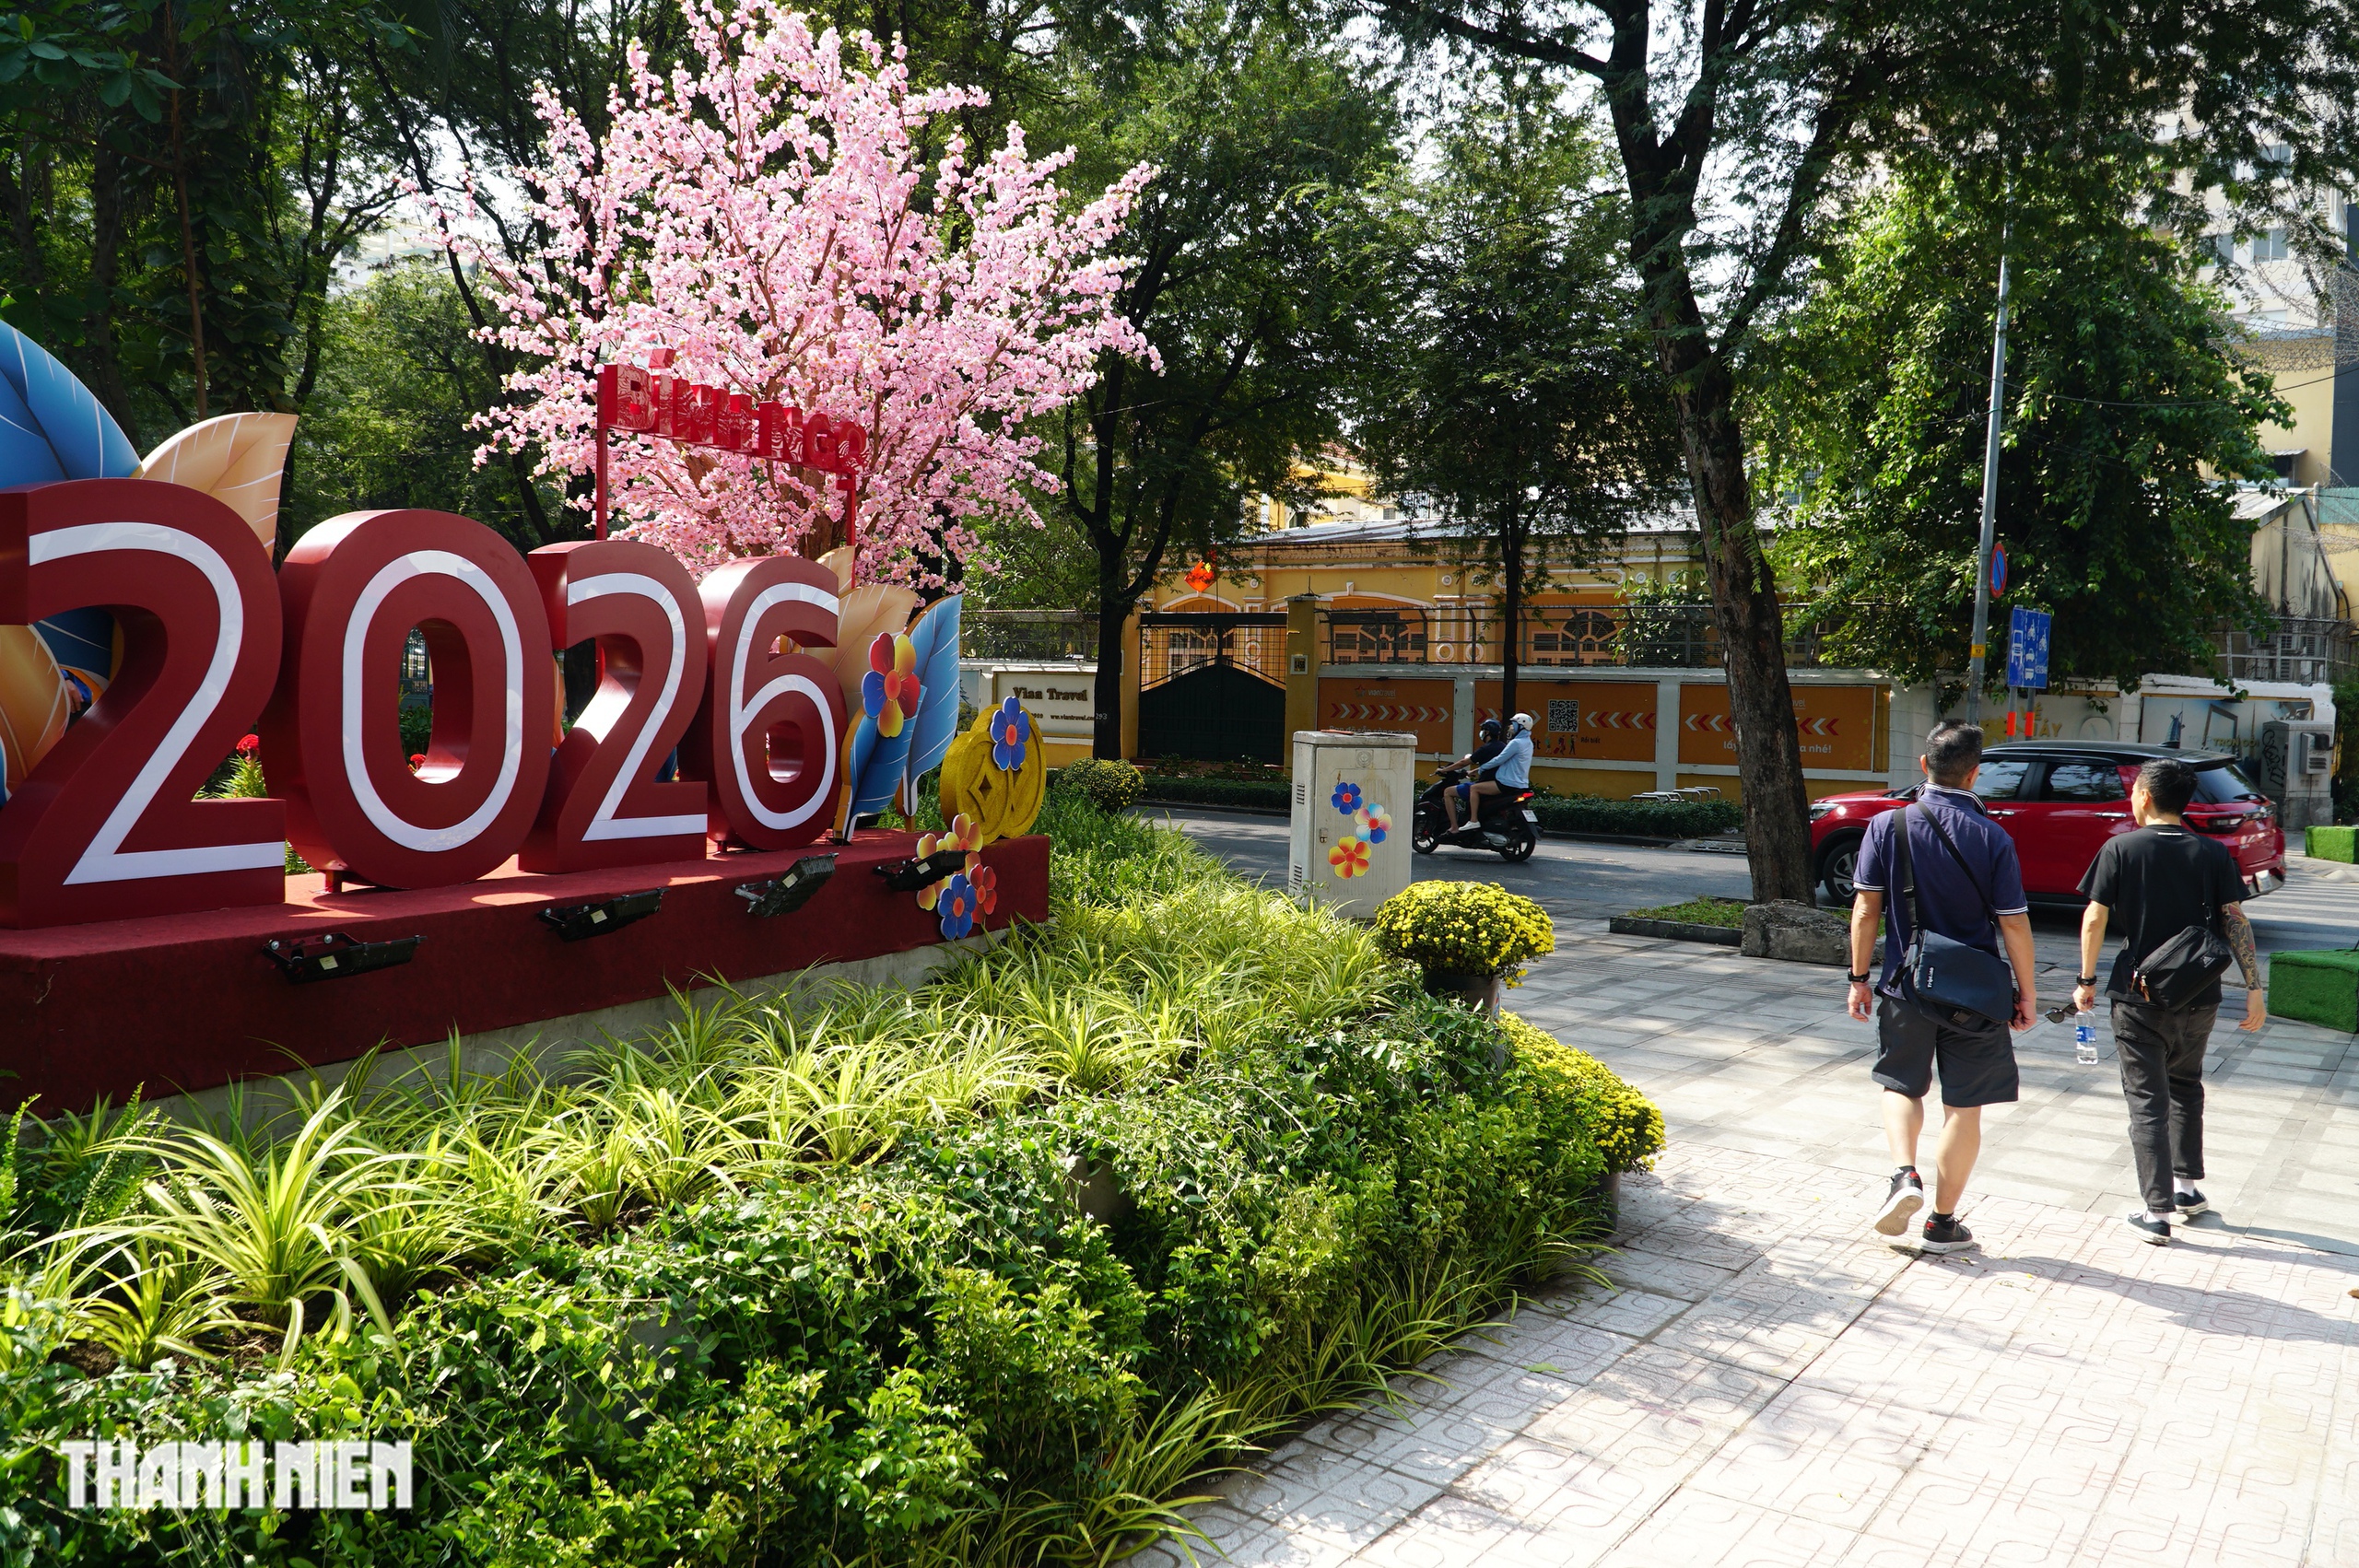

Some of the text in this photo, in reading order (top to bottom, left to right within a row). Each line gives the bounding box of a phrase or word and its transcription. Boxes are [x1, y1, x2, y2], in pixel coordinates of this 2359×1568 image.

[0, 477, 846, 924] 2026
[1013, 687, 1088, 701] Vian Travel
[1809, 743, 1832, 754] nhé!
